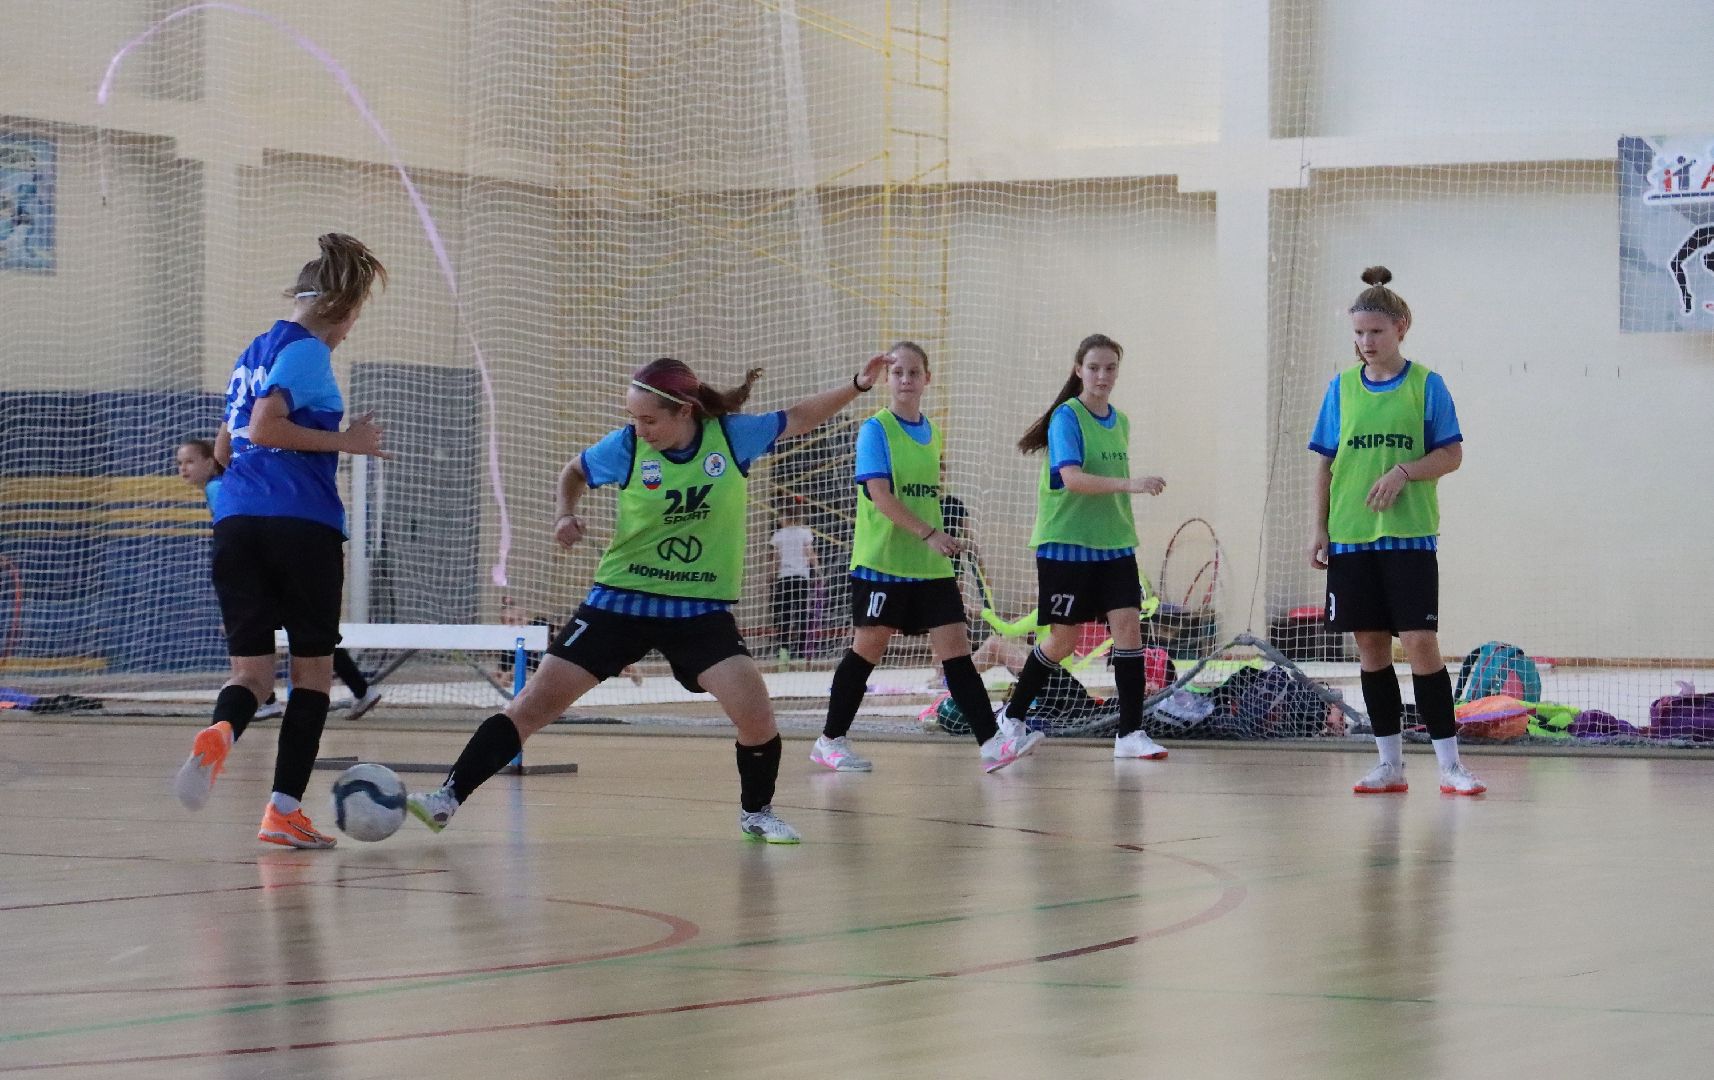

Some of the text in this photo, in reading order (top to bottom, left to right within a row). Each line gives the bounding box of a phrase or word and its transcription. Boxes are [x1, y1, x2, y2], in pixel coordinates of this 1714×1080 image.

[664, 510, 711, 525] SPORT
[867, 591, 887, 618] 10
[1051, 593, 1075, 617] 27
[563, 618, 589, 647] 7
